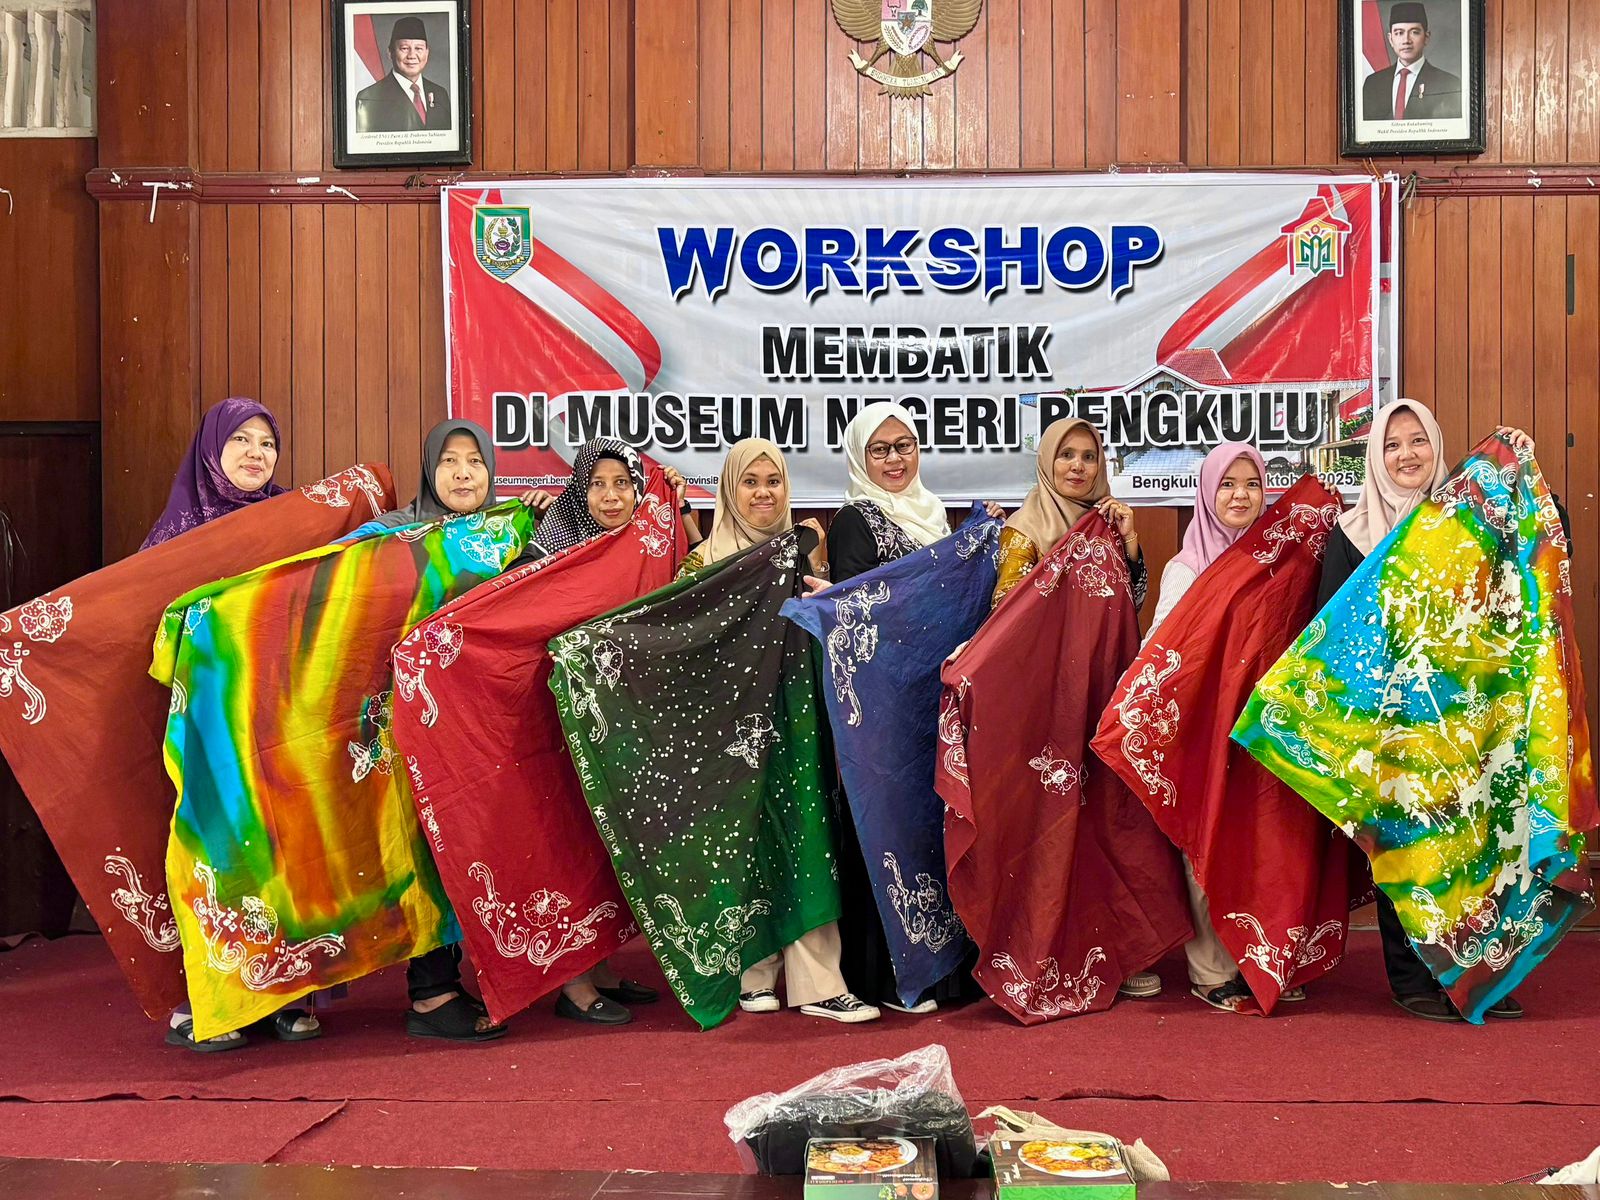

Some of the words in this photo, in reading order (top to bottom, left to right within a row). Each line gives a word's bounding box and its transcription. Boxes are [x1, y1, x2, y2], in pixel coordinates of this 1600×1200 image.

[657, 225, 1163, 301] WORKSHOP
[763, 325, 1051, 378] MEMBATIK
[494, 395, 549, 447] DI
[567, 394, 804, 447] MUSEUM
[825, 396, 1018, 447] NGERI
[494, 474, 573, 487] useumnegeri.beng
[1267, 472, 1299, 487] ktob
